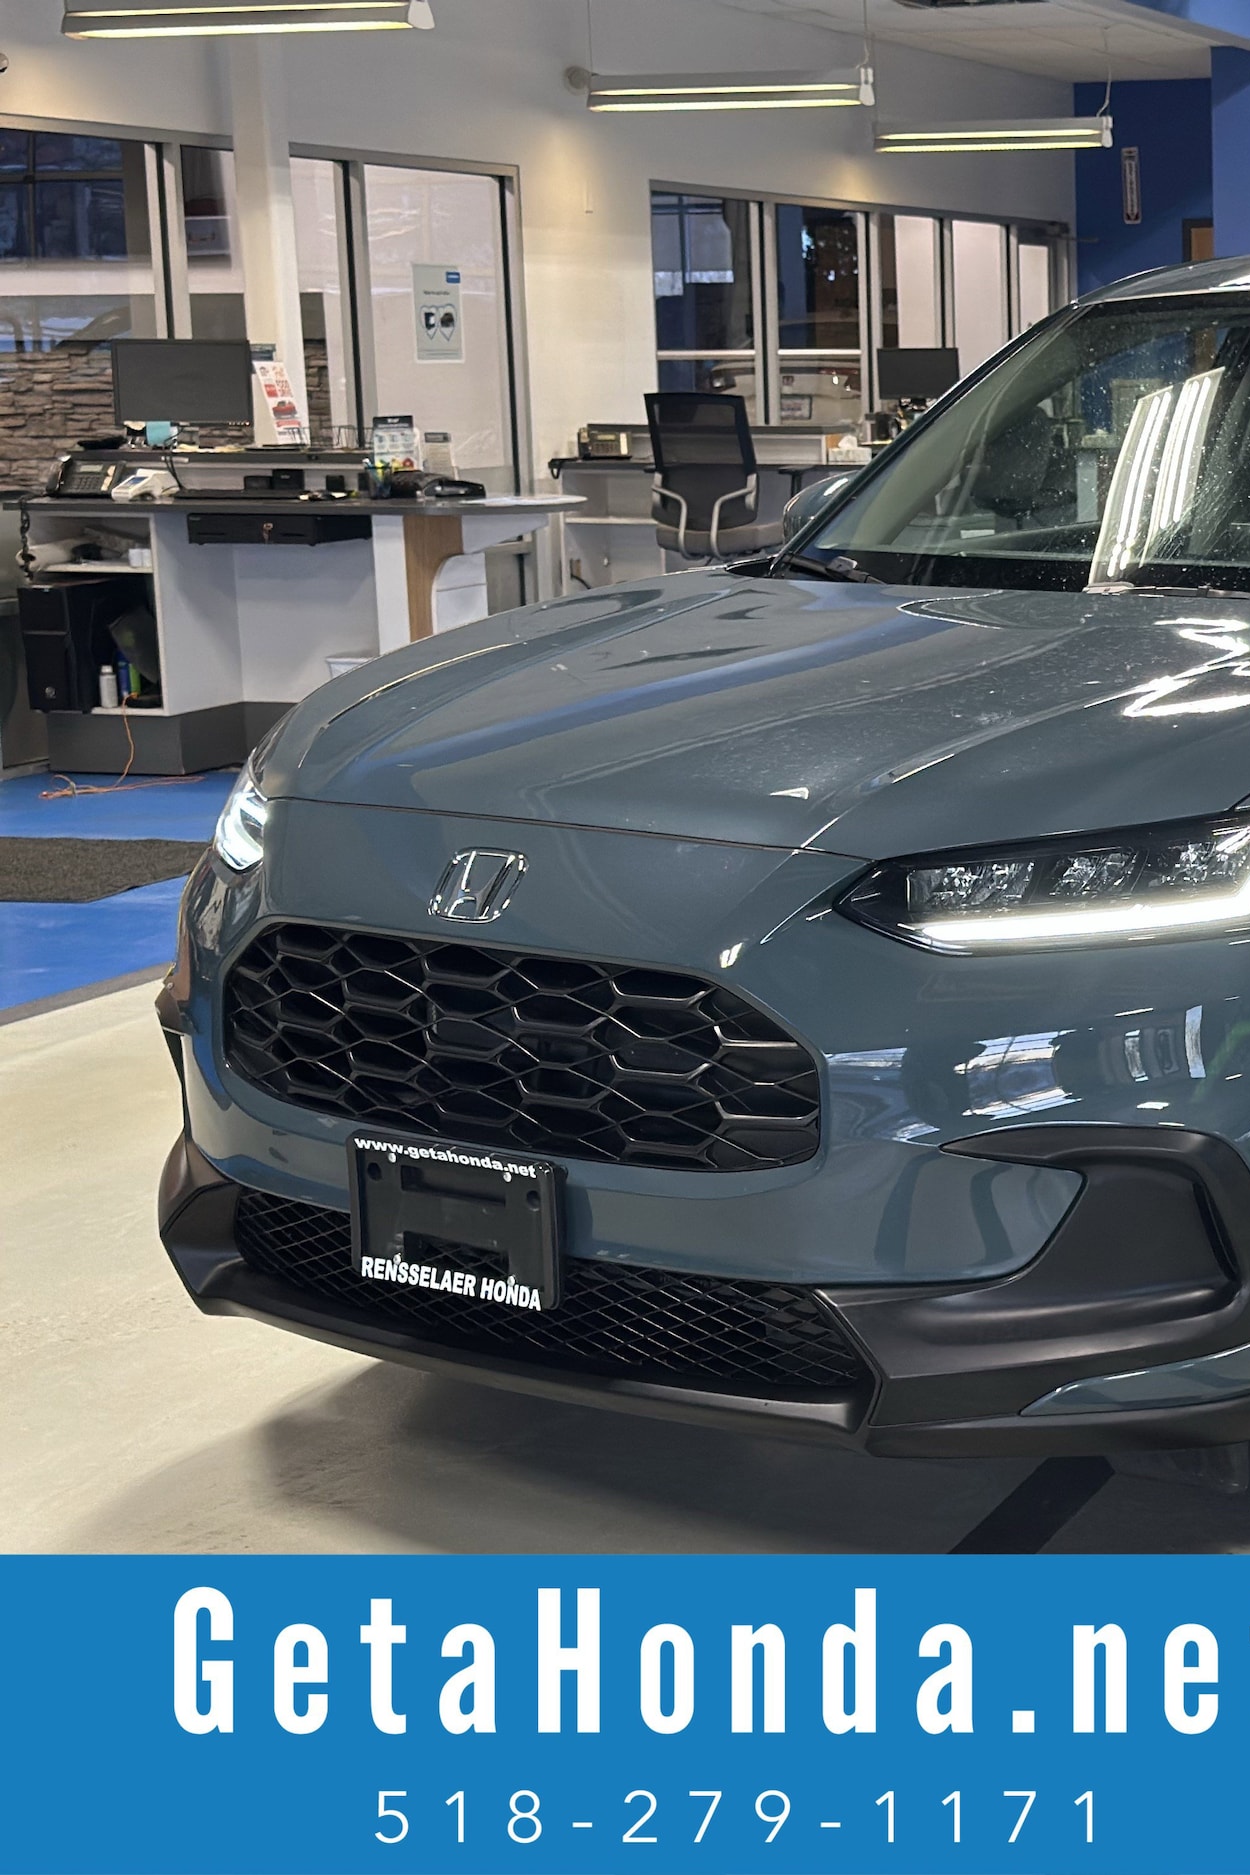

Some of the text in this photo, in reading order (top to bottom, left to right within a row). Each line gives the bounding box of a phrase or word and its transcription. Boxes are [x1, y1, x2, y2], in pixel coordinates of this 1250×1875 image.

[354, 1138, 537, 1179] www.getahonda.net
[361, 1256, 542, 1311] RENSSELAER HONDA
